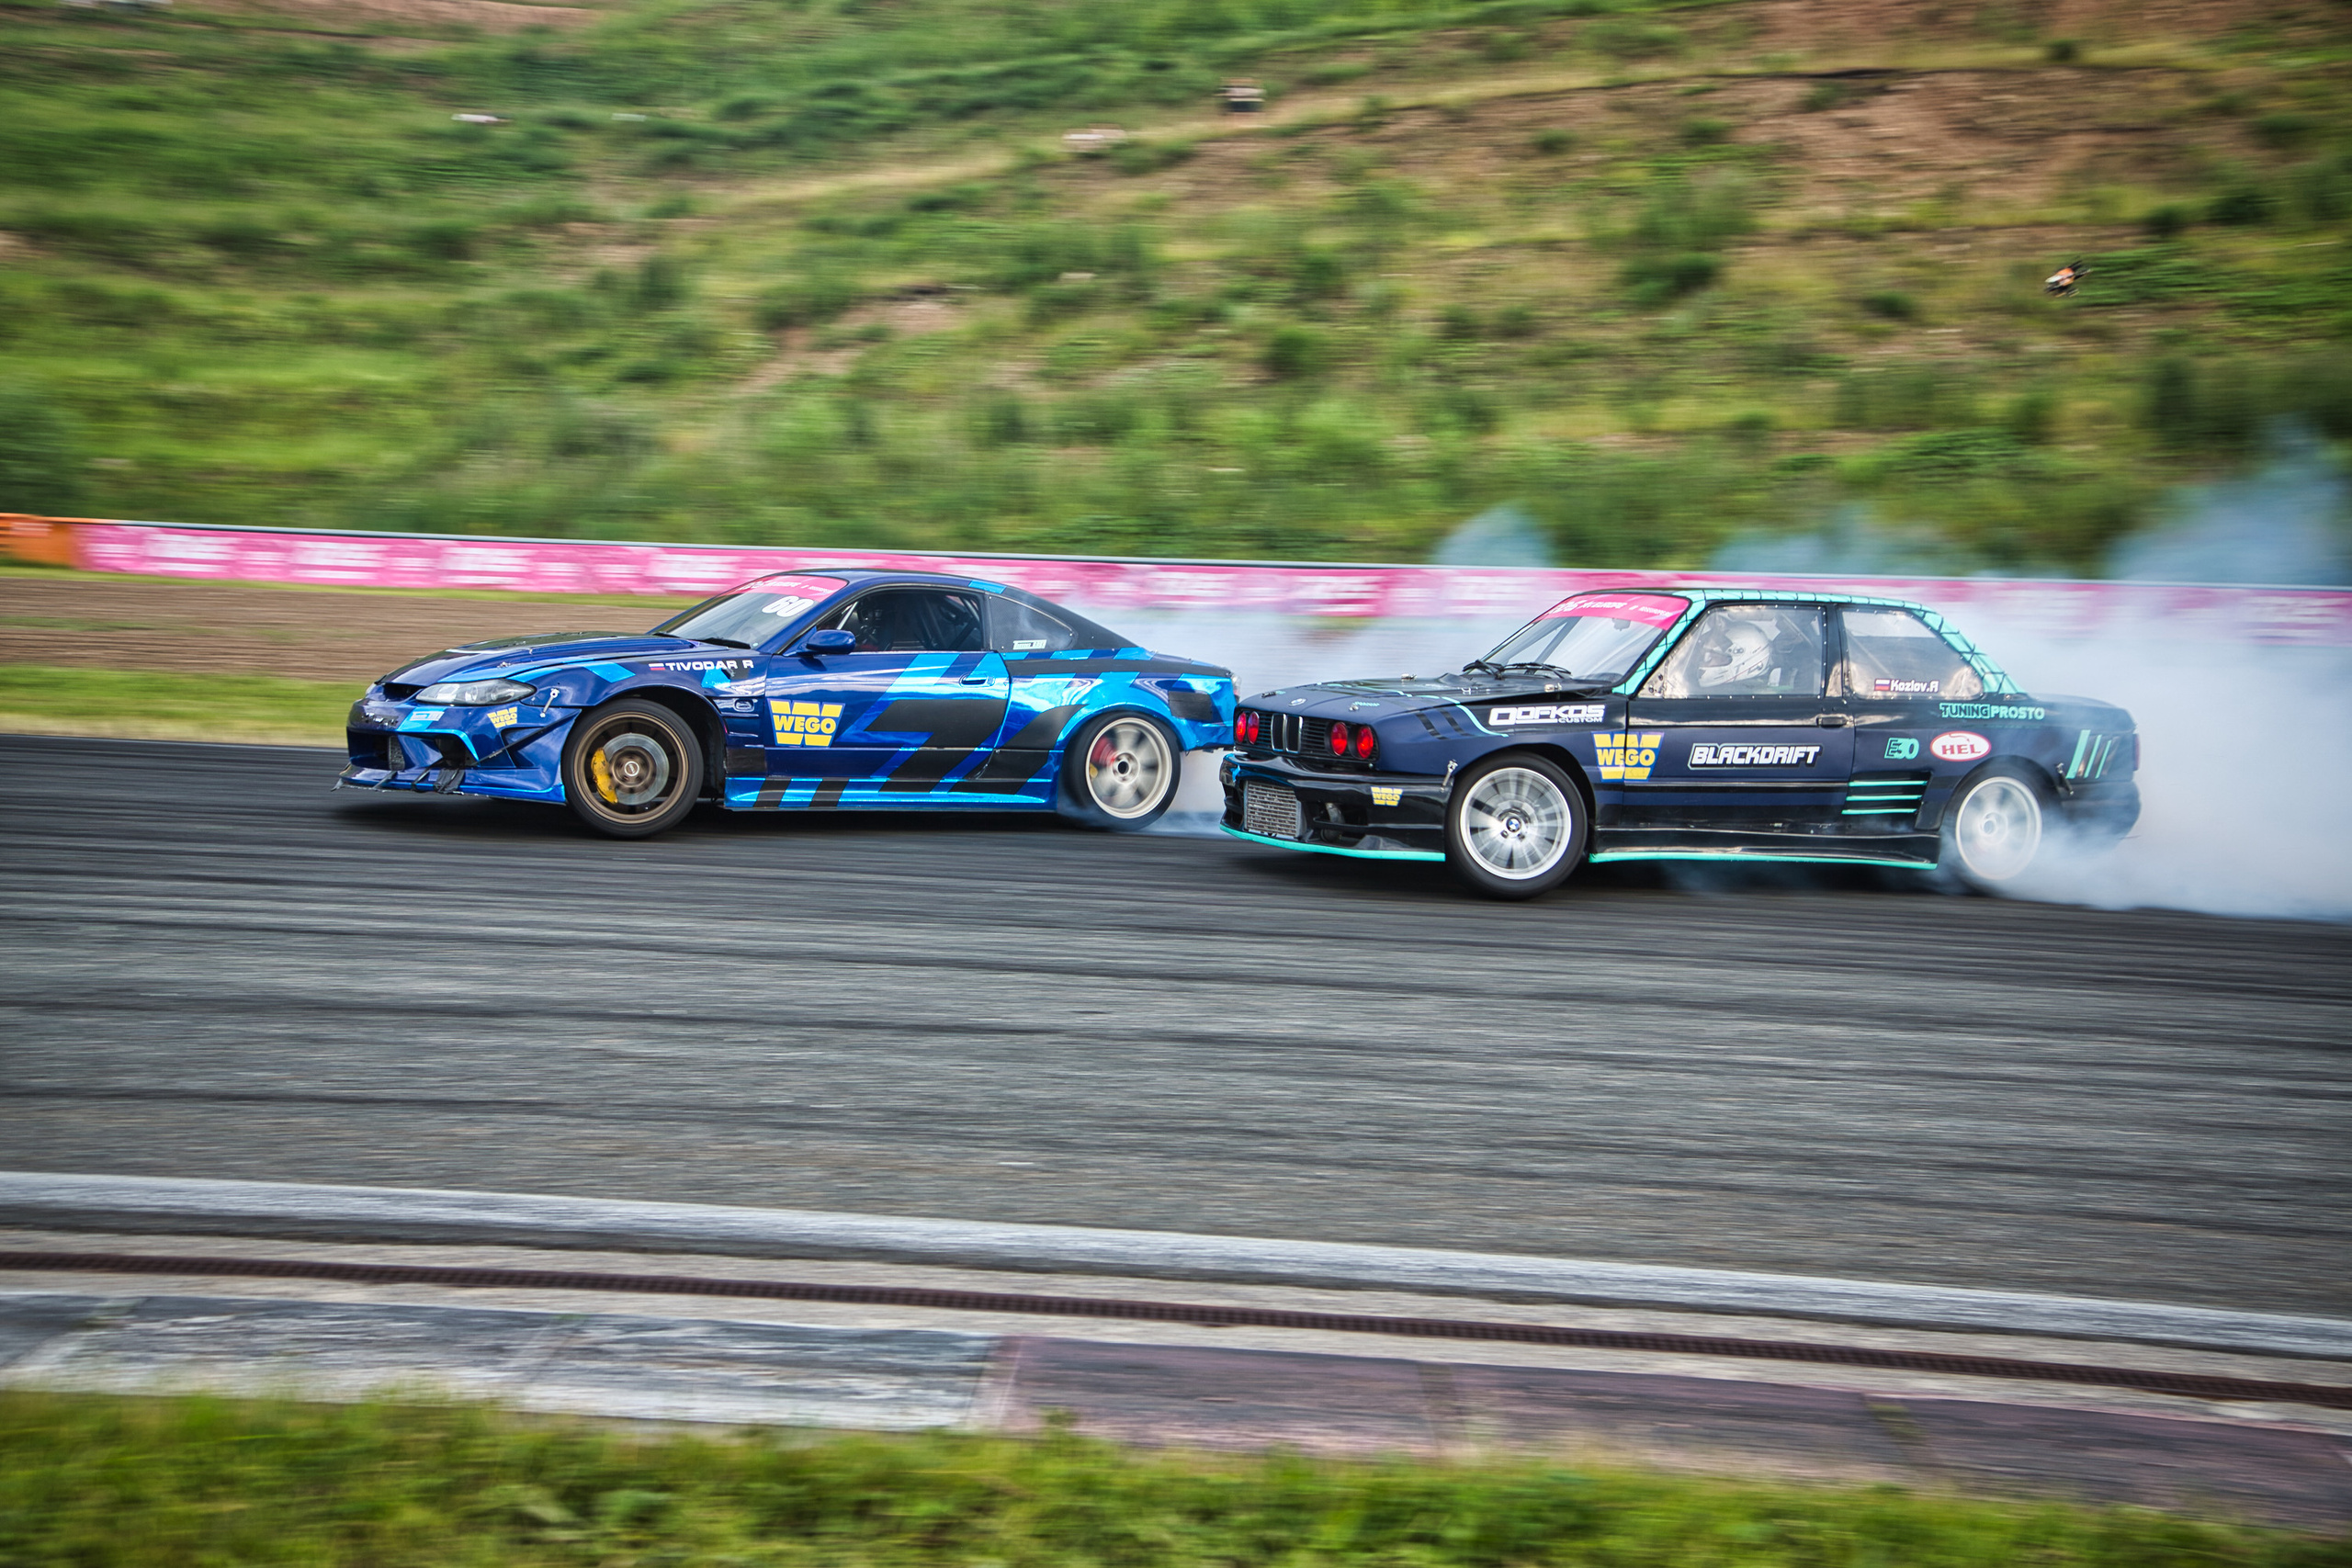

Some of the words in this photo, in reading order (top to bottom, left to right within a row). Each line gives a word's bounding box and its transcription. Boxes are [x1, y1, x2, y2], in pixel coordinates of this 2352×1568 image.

[762, 595, 814, 617] 60
[665, 660, 738, 671] TIVODAR
[742, 660, 753, 669] R
[491, 713, 517, 724] WEGO
[1939, 703, 1990, 718] TUNING
[1990, 705, 2045, 720] PROSTO
[773, 715, 836, 734] WEGO
[1691, 746, 1821, 764] BLACKDRIFT
[1884, 738, 1919, 759] E30
[1941, 743, 1982, 755] HEL
[1597, 749, 1656, 766] WEGO
[1372, 792, 1401, 801] WEGO
